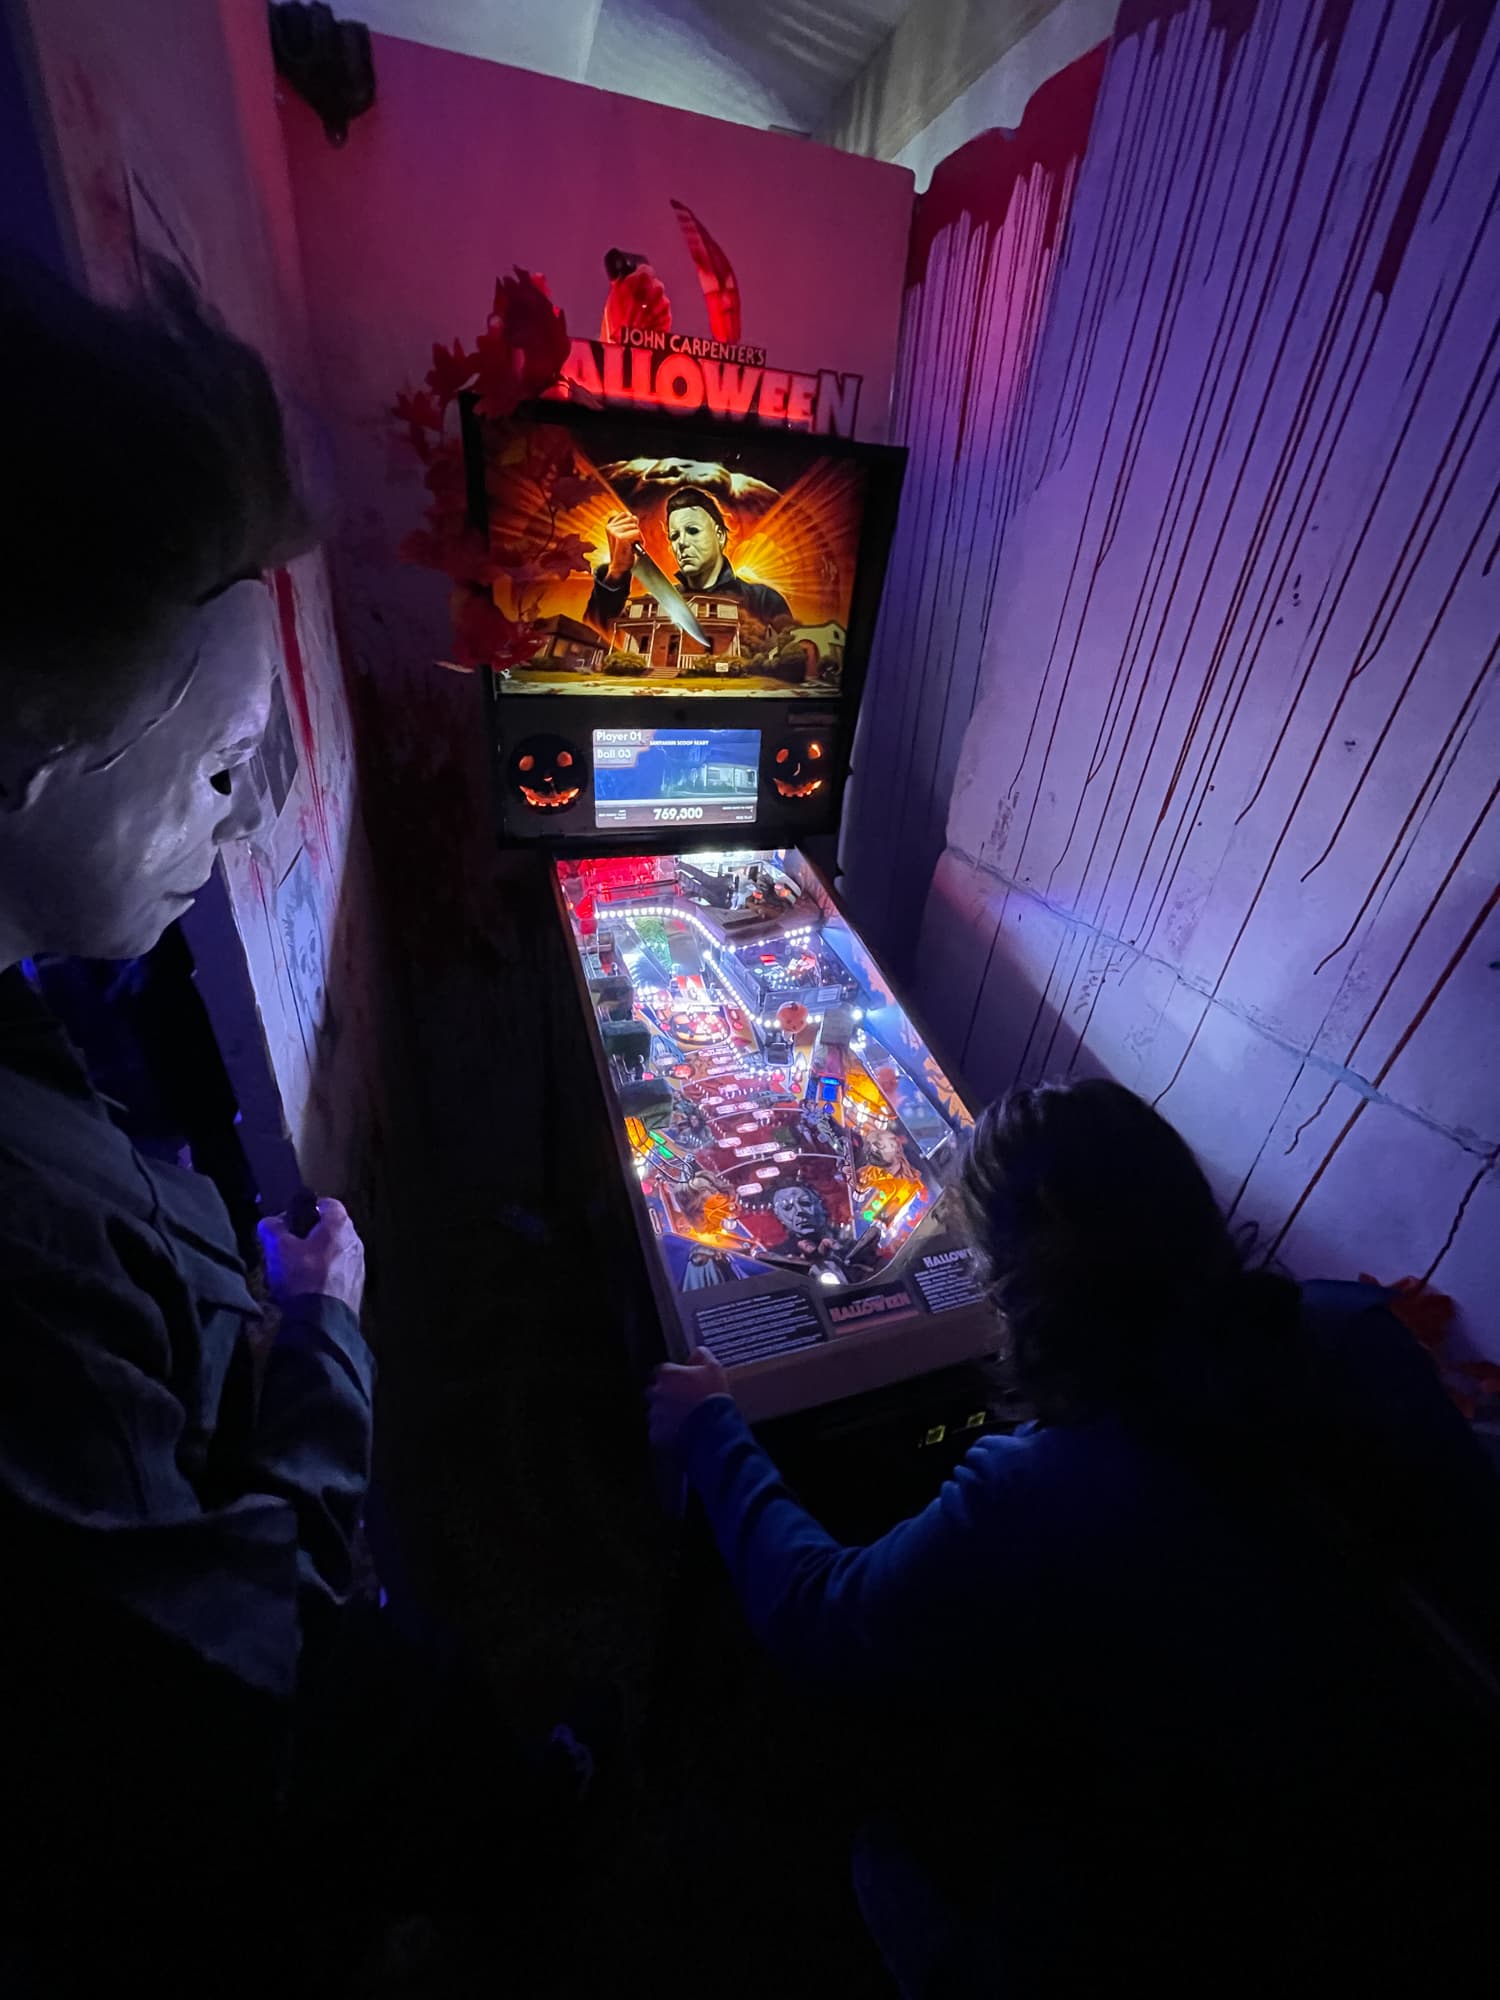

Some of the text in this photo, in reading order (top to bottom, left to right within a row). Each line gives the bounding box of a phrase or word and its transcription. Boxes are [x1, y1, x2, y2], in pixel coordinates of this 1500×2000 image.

[623, 326, 766, 366] JOHN CARPENTER'S
[560, 337, 863, 441] ALLOWEEN
[596, 731, 642, 743] Player 01
[597, 749, 632, 759] Ball 03
